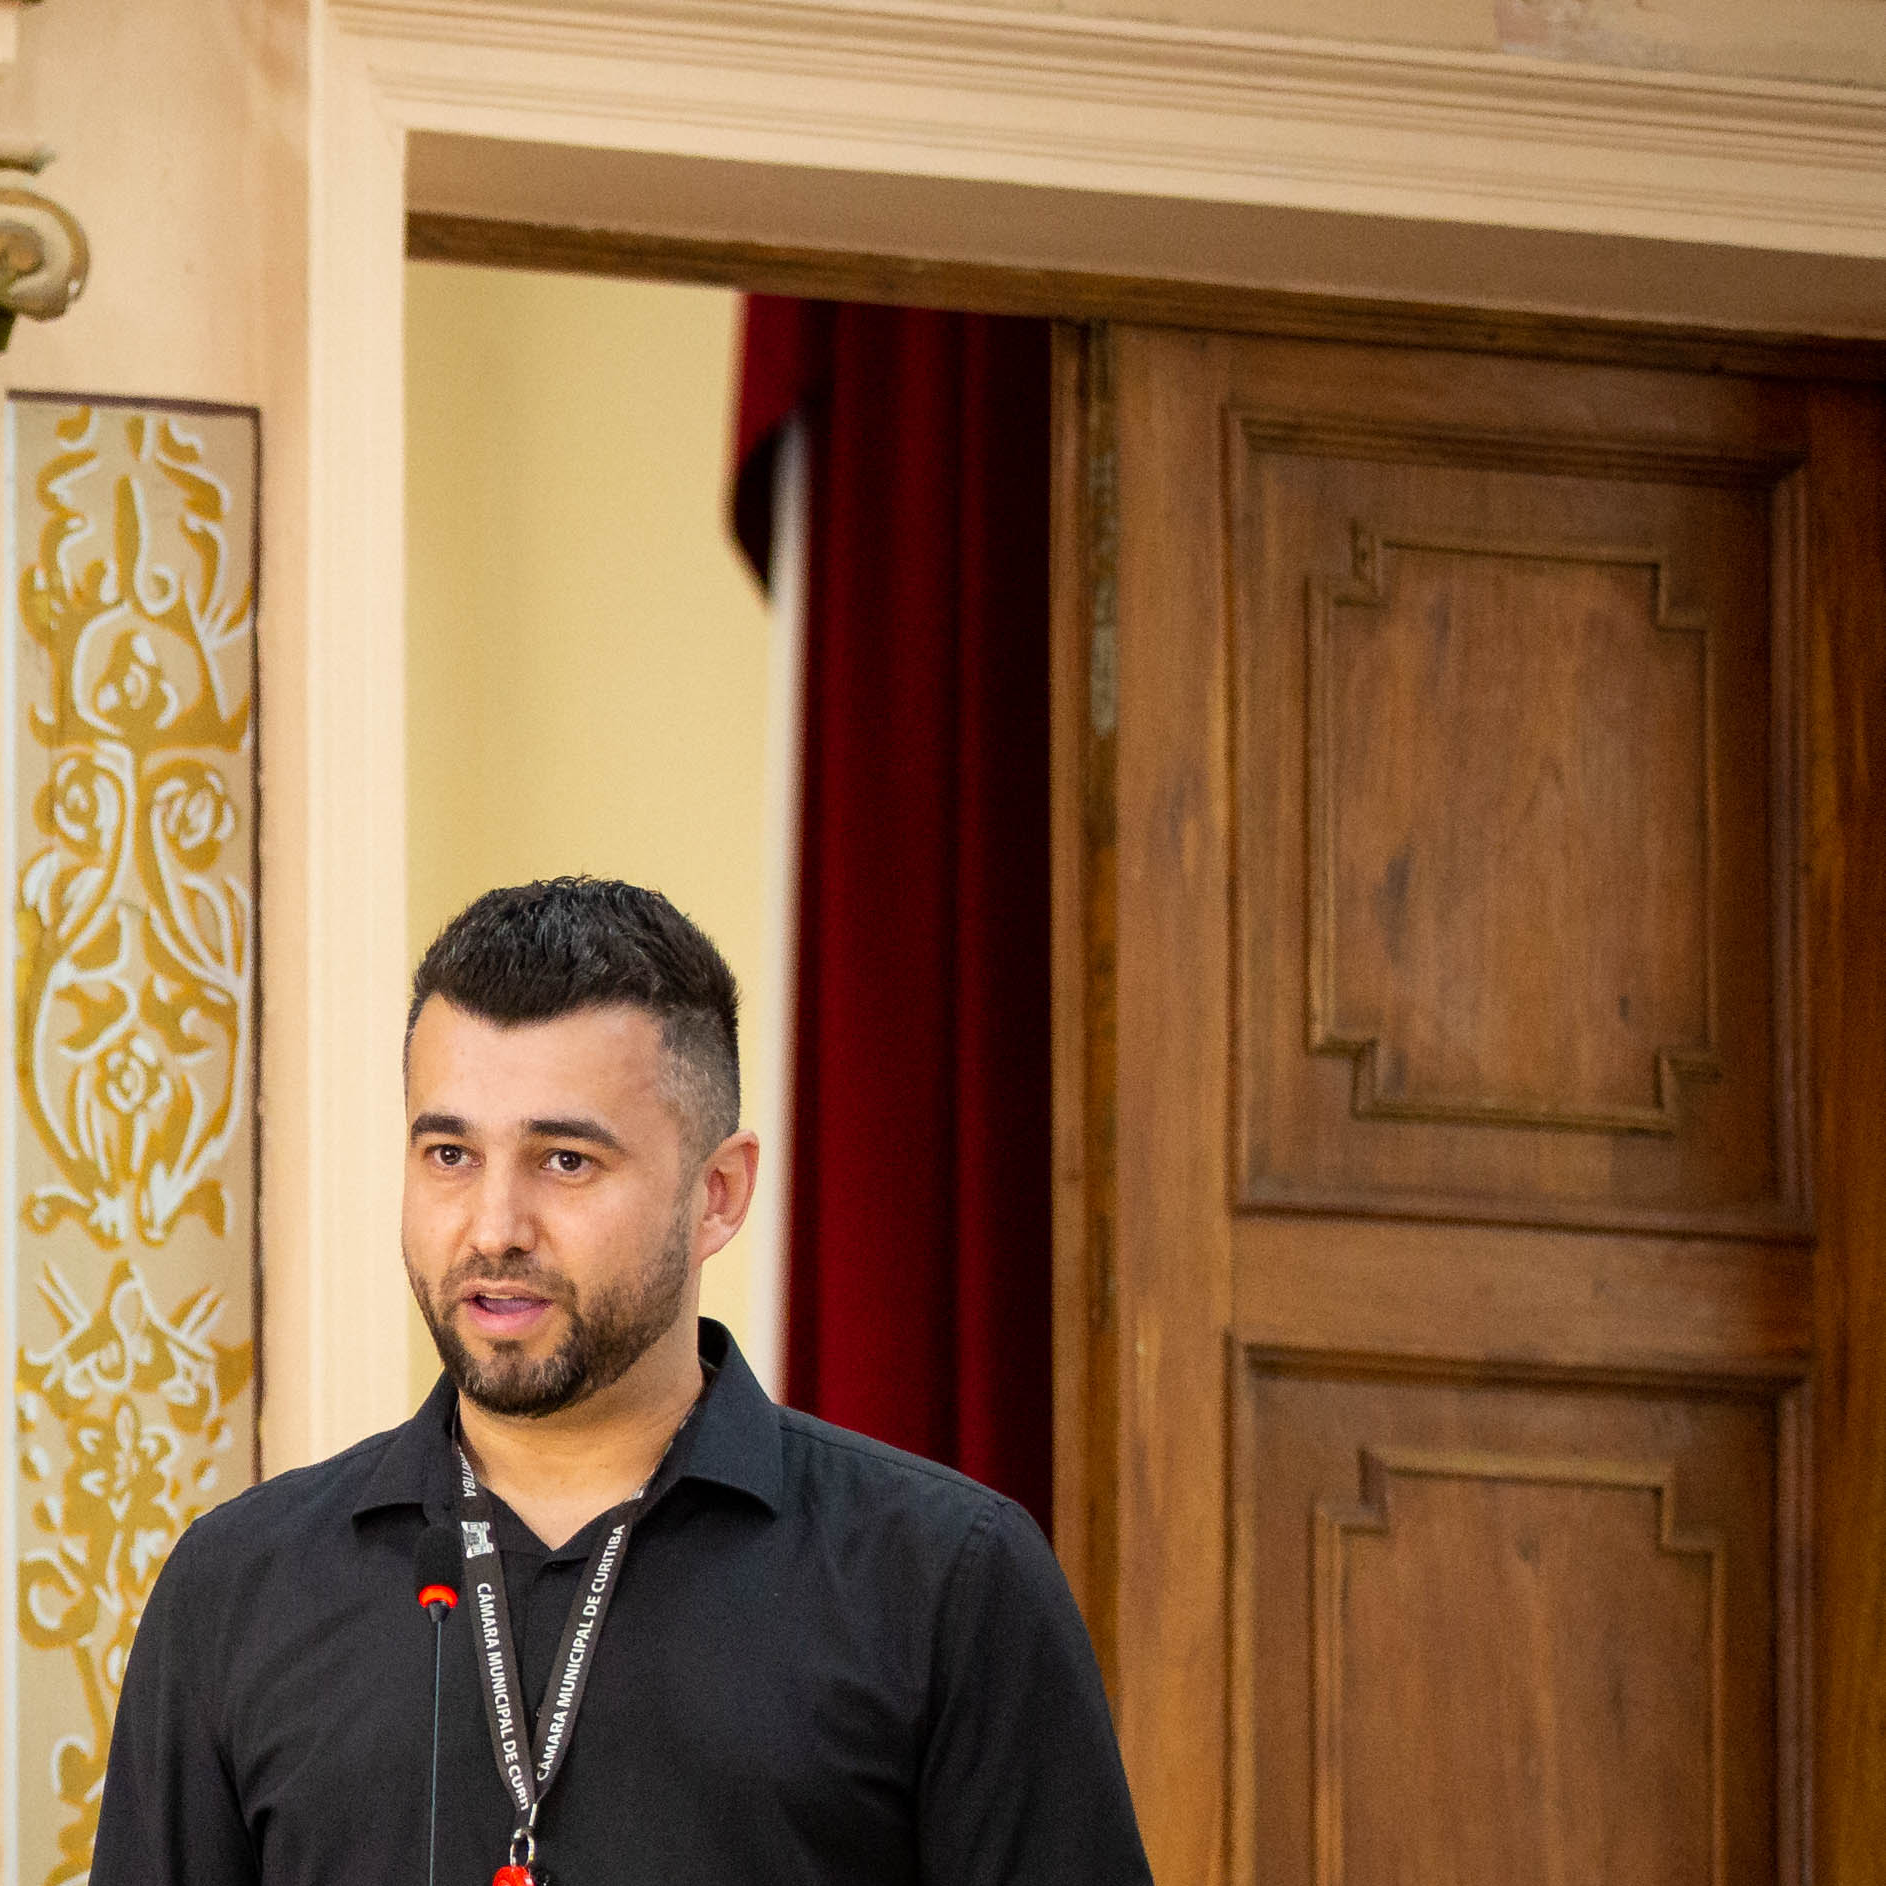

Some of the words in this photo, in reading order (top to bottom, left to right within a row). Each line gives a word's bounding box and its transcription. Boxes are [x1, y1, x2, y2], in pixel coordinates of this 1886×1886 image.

[591, 1524, 626, 1593] CURITIBA
[476, 1582, 500, 1650] CÂMARA
[583, 1595, 601, 1617] DE
[487, 1651, 514, 1739] MUNICIPAL
[556, 1619, 593, 1707] MUNICIPAL
[502, 1740, 519, 1764] DE
[537, 1710, 568, 1781] CÂMARA
[508, 1764, 530, 1811] CURIT
